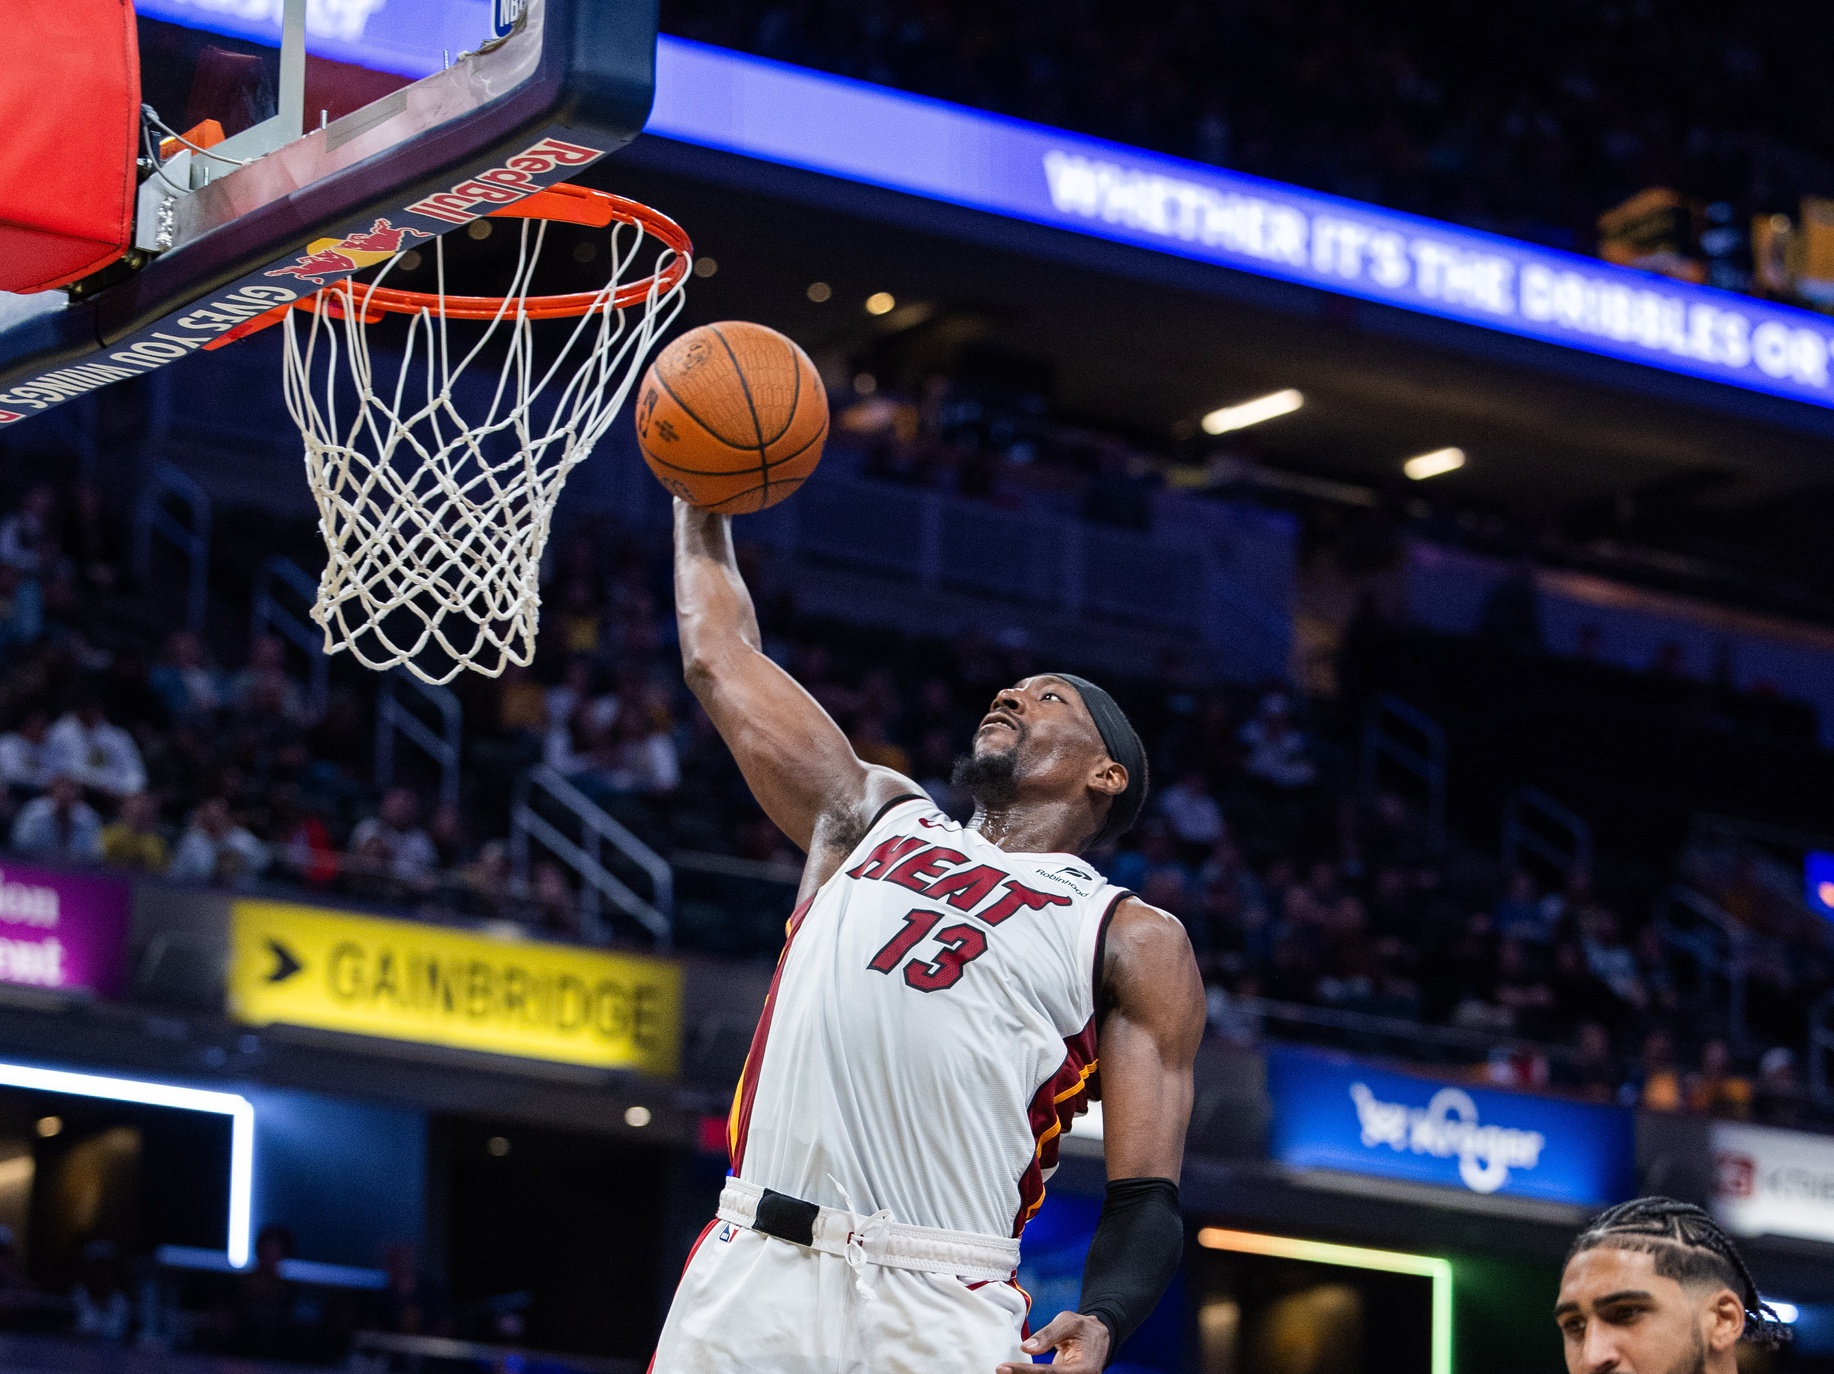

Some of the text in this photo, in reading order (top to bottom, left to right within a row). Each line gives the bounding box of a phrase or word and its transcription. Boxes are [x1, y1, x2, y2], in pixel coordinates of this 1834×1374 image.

[403, 137, 605, 225] Red Bull
[177, 285, 297, 332] GIVES
[1043, 149, 1308, 268] WHETHER
[1409, 238, 1515, 316] THE
[1518, 262, 1752, 369] DRIBBLES
[1751, 320, 1829, 390] OR
[109, 332, 213, 368] YOU
[846, 833, 1073, 927] HEAT
[1035, 868, 1090, 898] Robinhood
[866, 908, 988, 993] 13
[327, 941, 660, 1051] GAINBRIDGE
